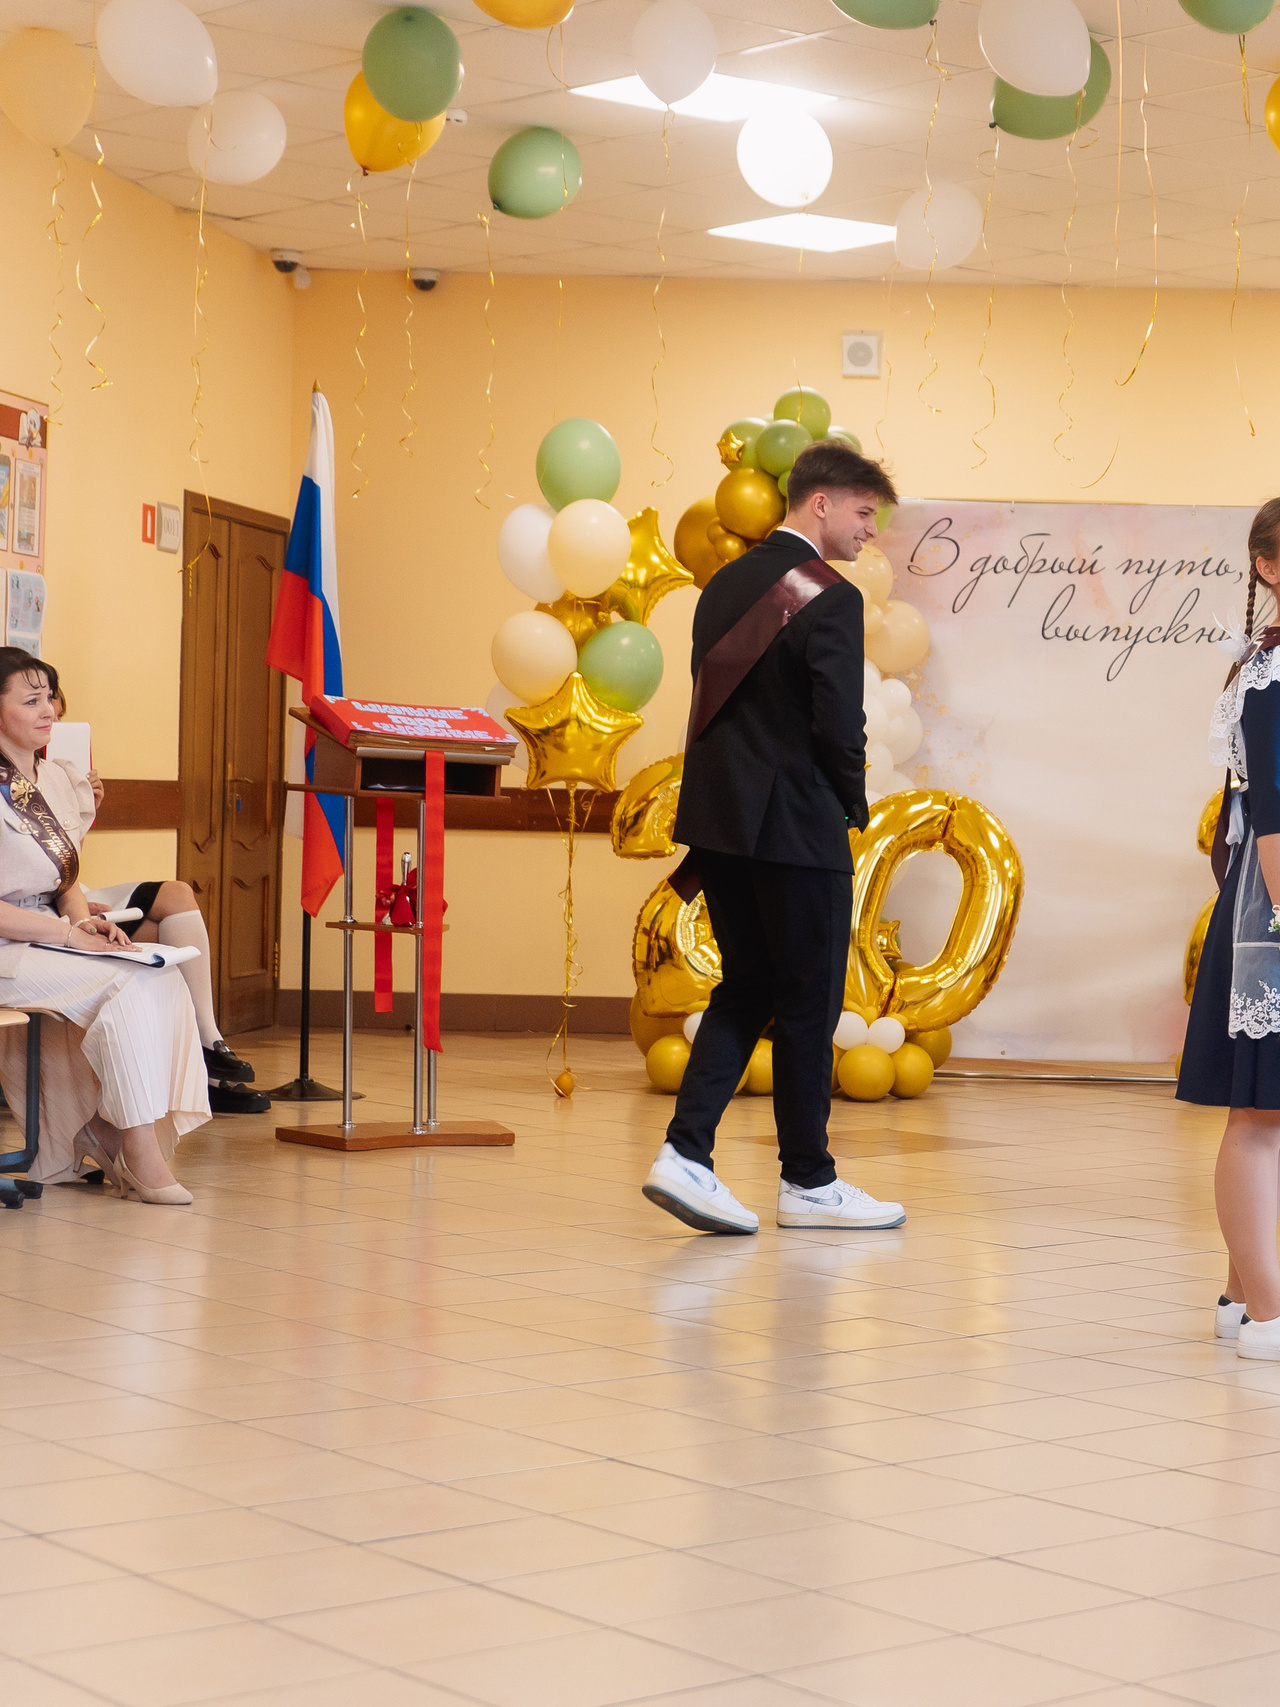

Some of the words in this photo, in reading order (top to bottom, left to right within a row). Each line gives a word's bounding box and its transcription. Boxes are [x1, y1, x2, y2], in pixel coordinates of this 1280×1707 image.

[907, 517, 960, 577] В
[952, 532, 1107, 614] добрый
[1116, 554, 1244, 615] путь,
